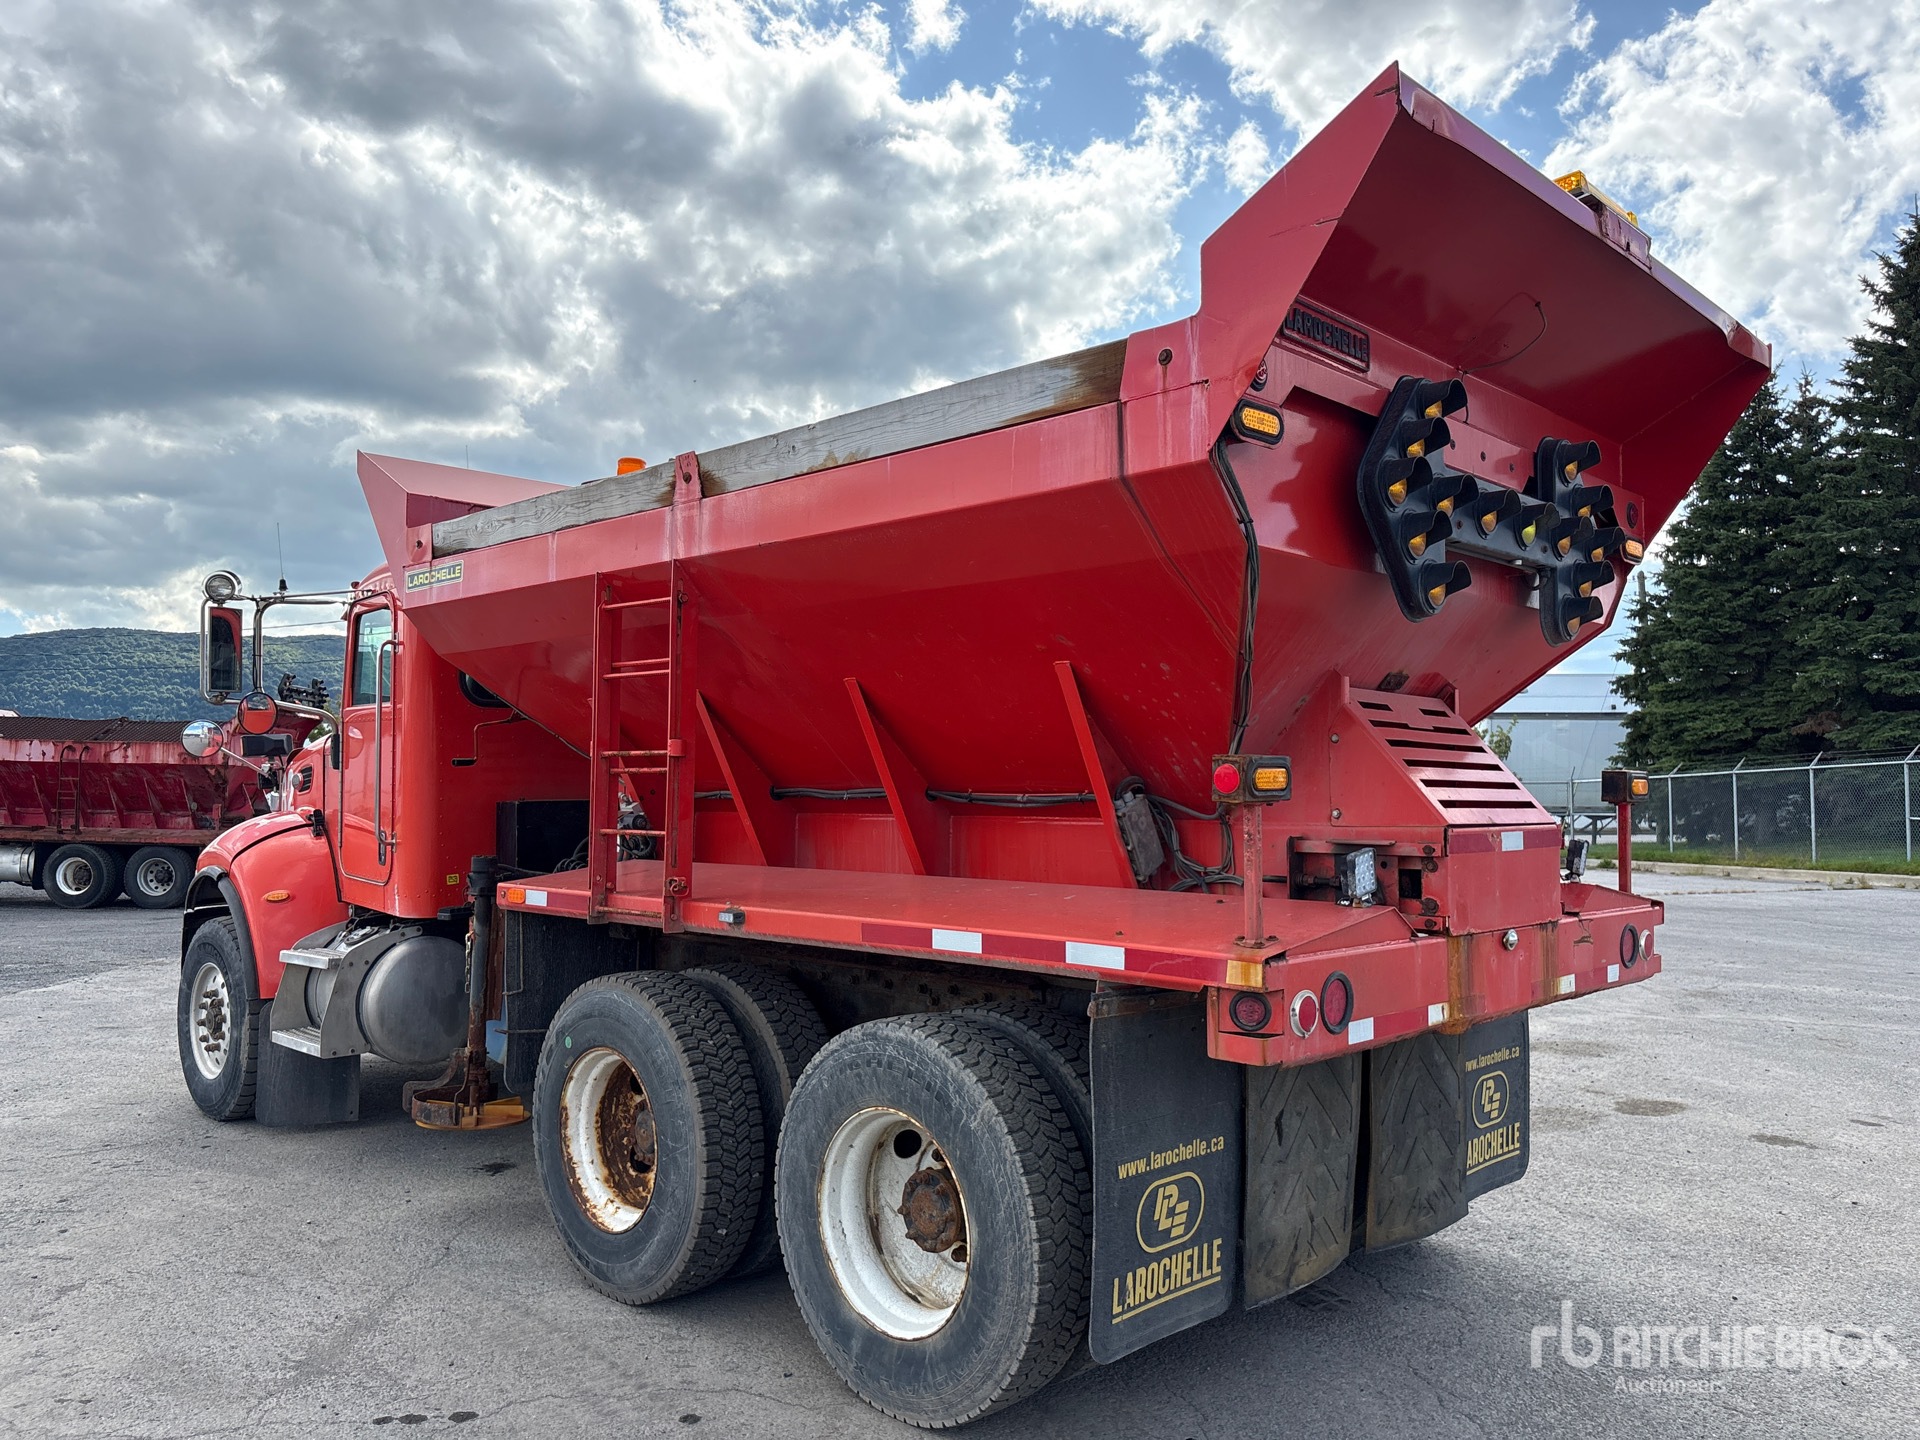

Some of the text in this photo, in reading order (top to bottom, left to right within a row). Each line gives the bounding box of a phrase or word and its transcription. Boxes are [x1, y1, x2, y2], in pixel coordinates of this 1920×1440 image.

[1284, 307, 1369, 363] LAROCHELLE
[407, 565, 462, 588] LAROCHELLE
[1117, 1135, 1225, 1180] www.larochelle.ca
[1466, 1121, 1521, 1169] AROCHELLE
[1112, 1237, 1223, 1315] LAROCHELLE
